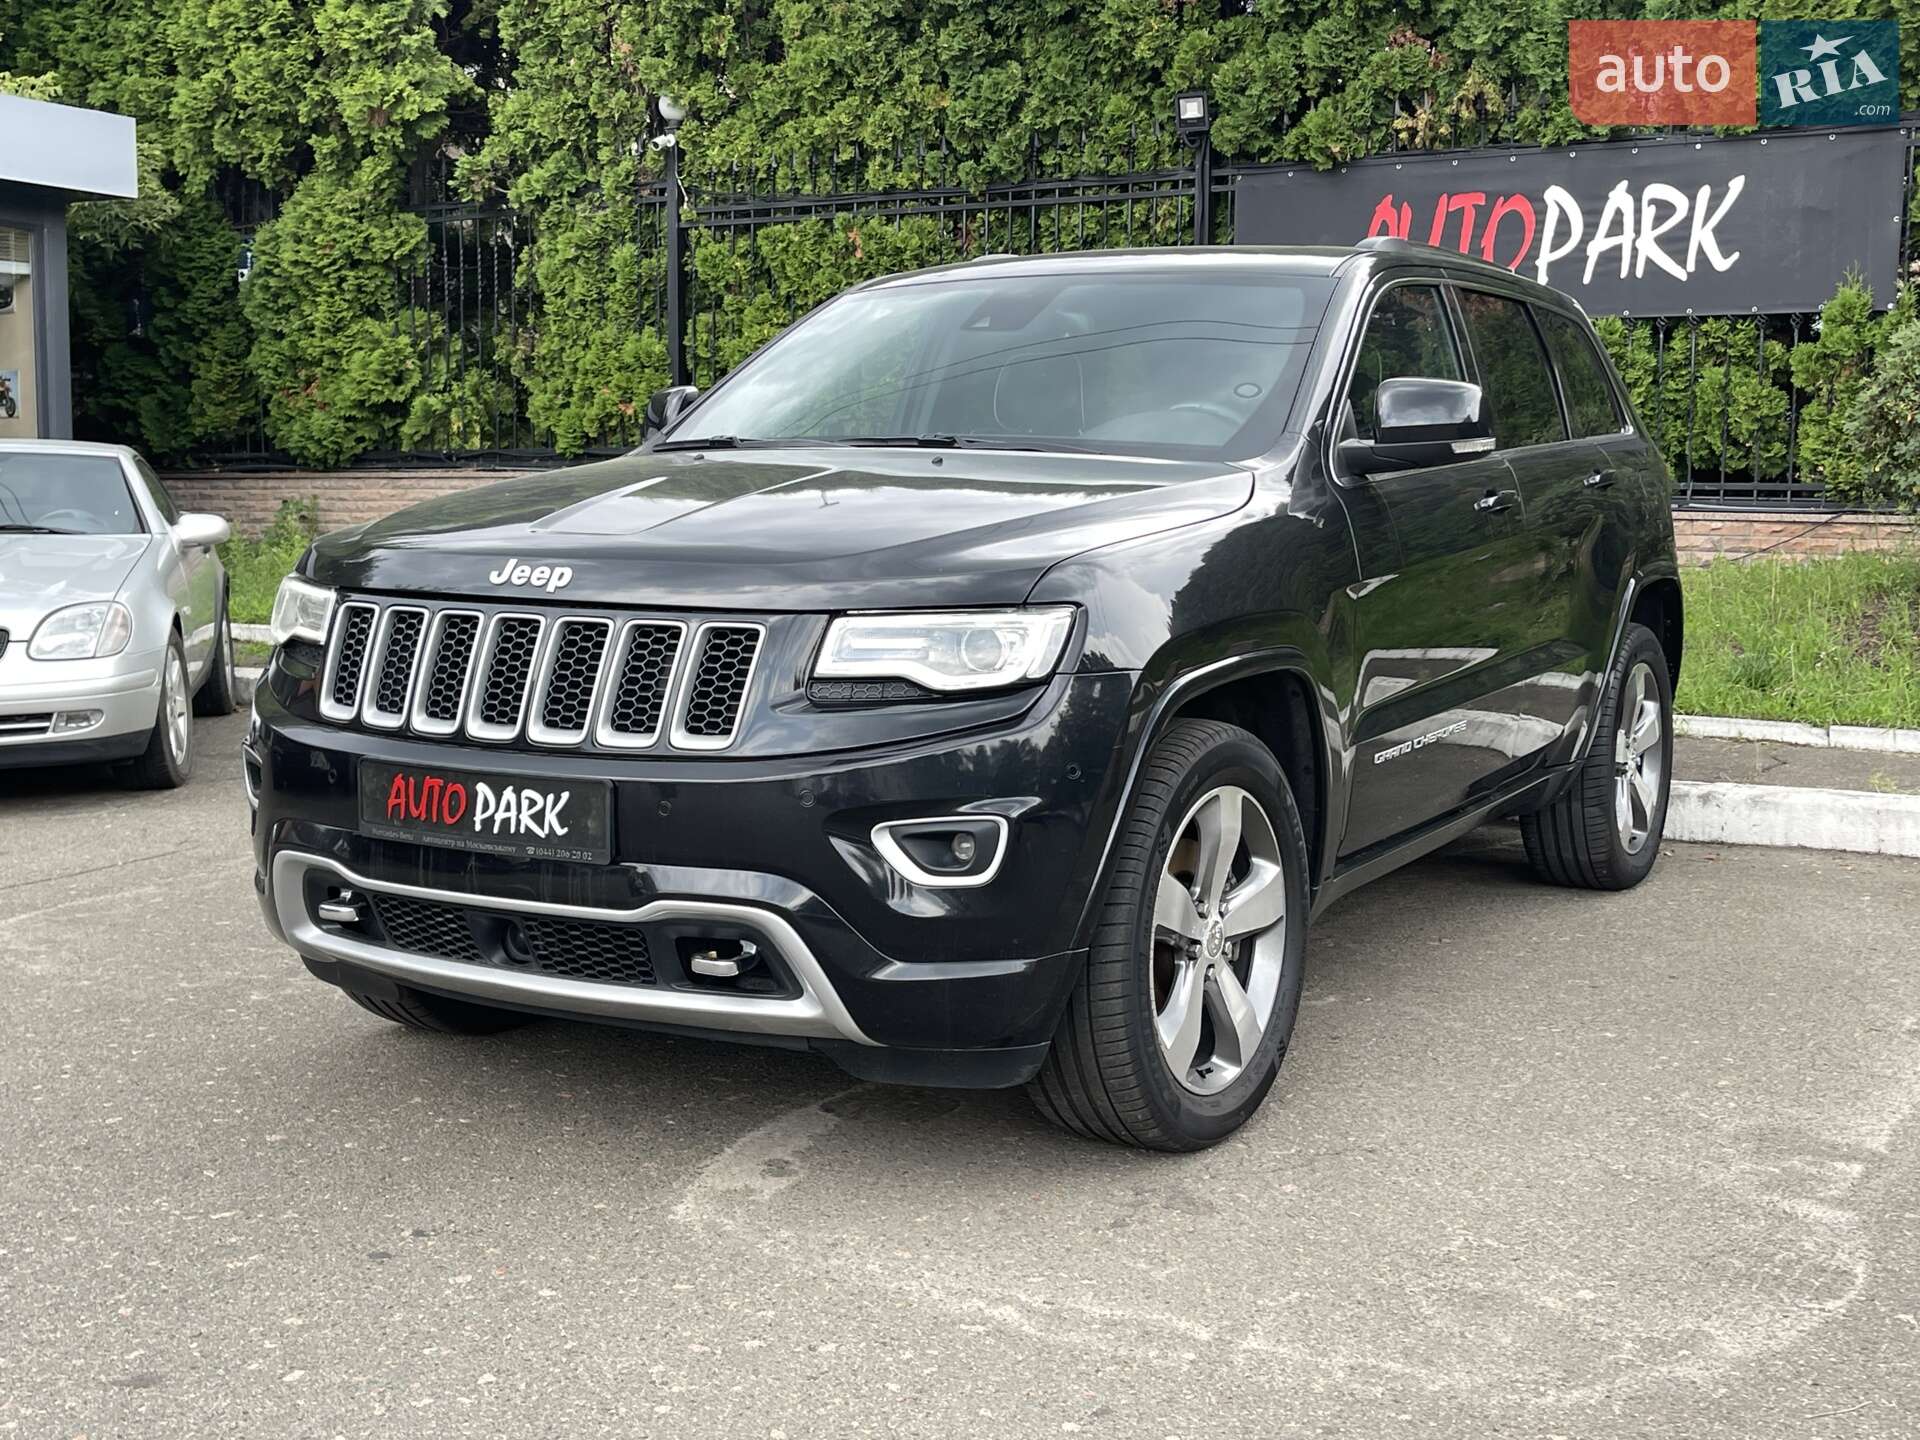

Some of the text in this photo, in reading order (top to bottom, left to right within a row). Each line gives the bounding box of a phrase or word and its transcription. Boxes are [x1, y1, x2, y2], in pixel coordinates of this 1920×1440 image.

[1534, 174, 1746, 286] PARK
[489, 558, 573, 593] Jeep
[1374, 740, 1413, 764] GRAND
[387, 773, 570, 838] AUTO PARK
